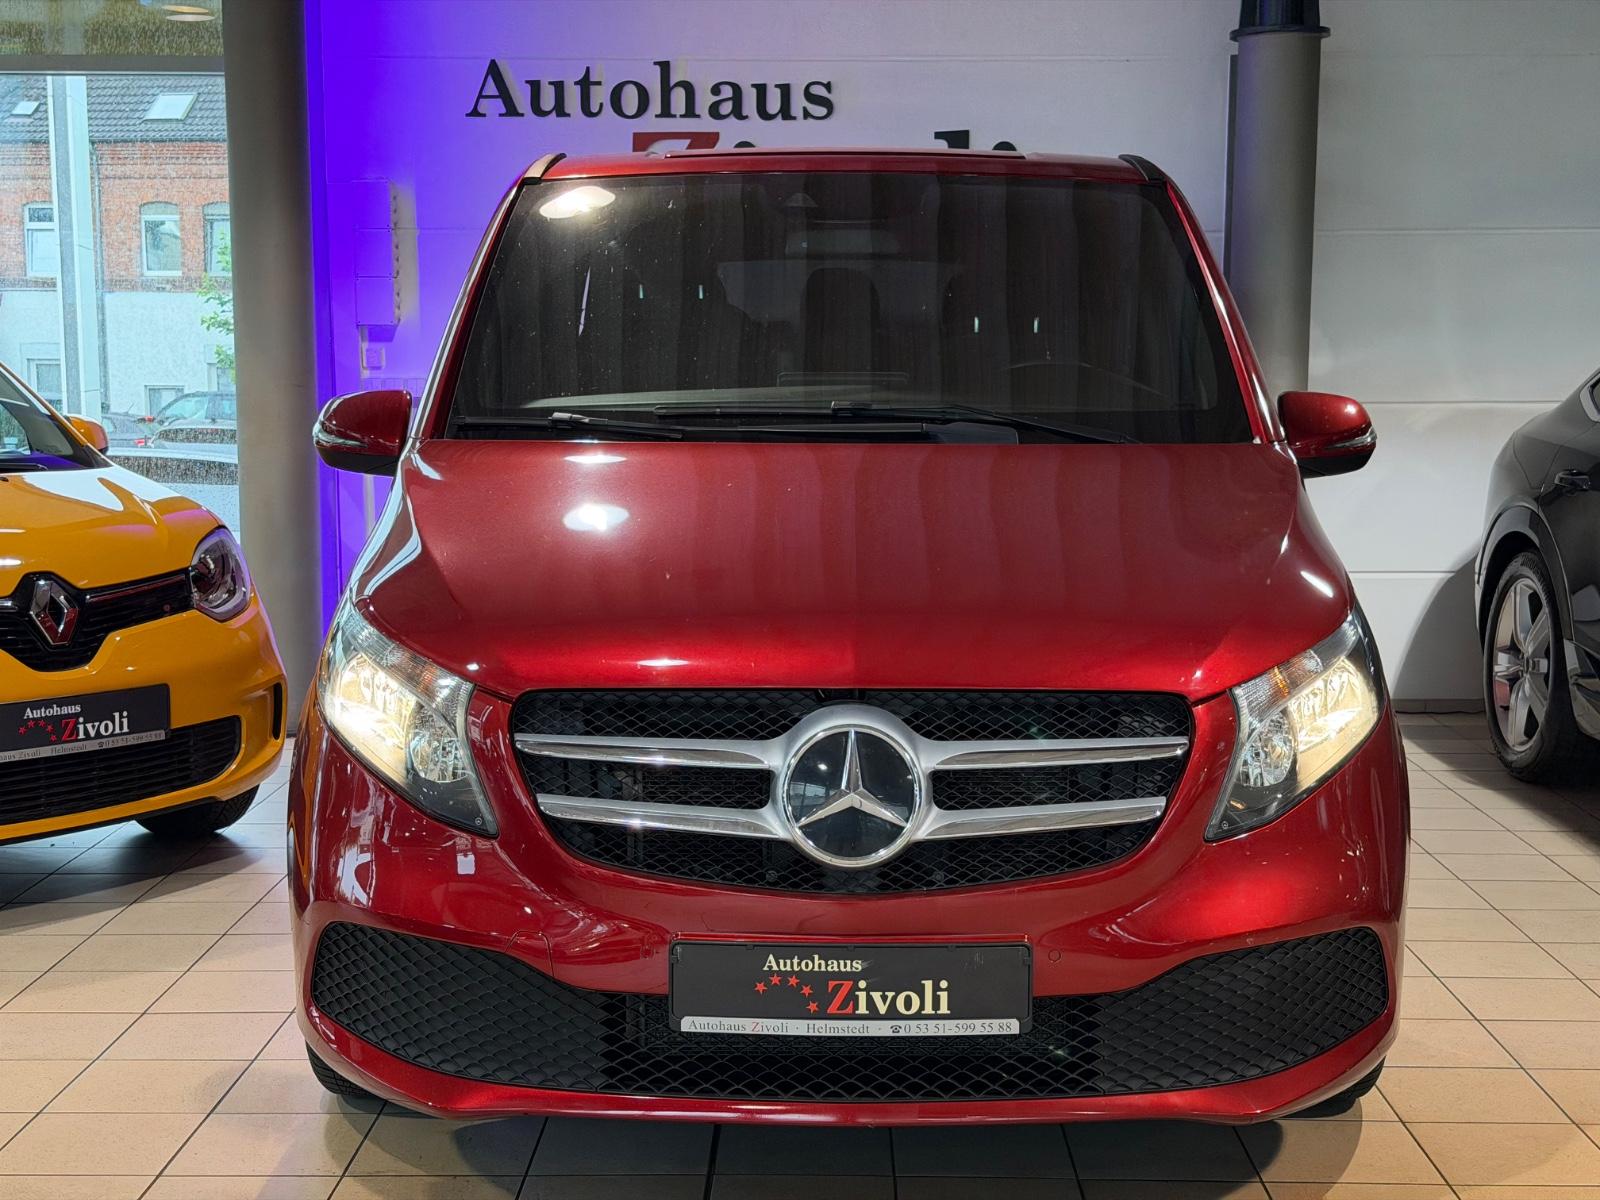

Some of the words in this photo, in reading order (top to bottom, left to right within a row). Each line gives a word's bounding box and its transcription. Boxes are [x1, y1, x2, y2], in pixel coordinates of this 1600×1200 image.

[465, 58, 835, 121] Autohaus
[24, 704, 81, 719] Autohaus
[61, 711, 129, 741] Zivoli
[762, 954, 862, 972] Autohaus
[827, 979, 951, 1015] Zivoli
[688, 1020, 746, 1032] Autohaus
[751, 1021, 789, 1033] Zivoli
[806, 1023, 870, 1034] Helmstedt
[915, 1023, 929, 1034] 53
[934, 1023, 976, 1034] 51-599
[979, 1022, 994, 1033] 55
[998, 1022, 1012, 1032] 88
